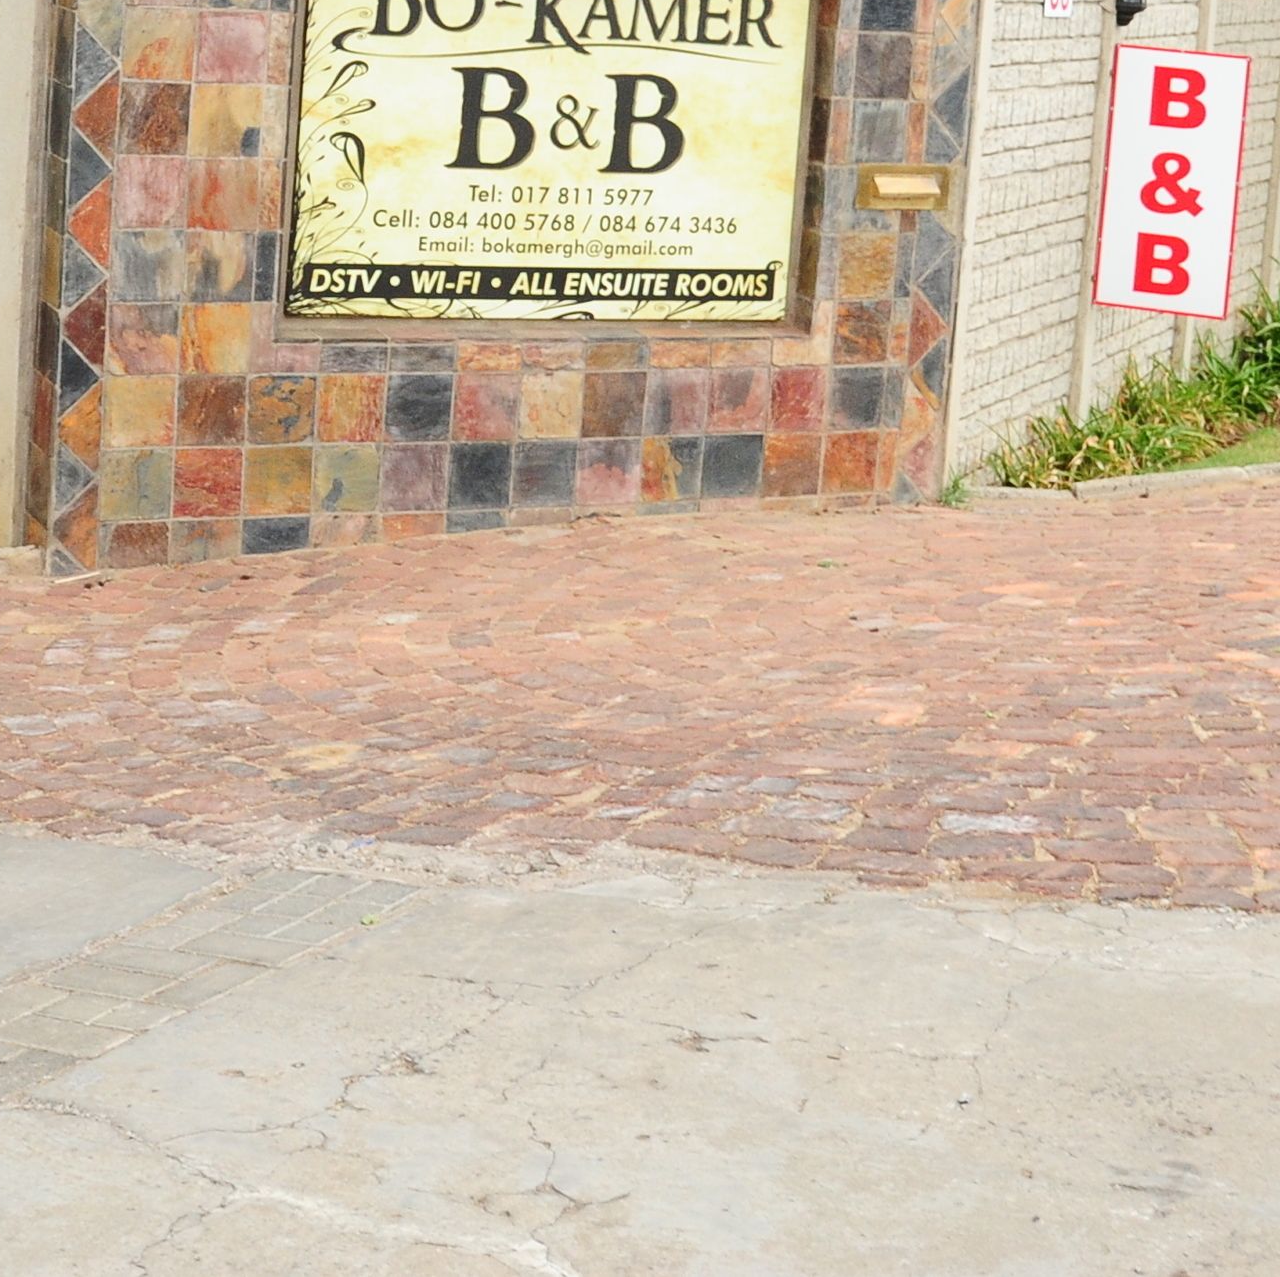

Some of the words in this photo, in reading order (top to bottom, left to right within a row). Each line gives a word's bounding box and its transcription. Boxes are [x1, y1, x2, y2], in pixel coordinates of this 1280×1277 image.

[469, 184, 502, 202] Tel:
[511, 185, 550, 204] 017
[558, 187, 593, 204] 811
[604, 188, 654, 206] 5977
[373, 209, 419, 228] Cell:
[429, 211, 468, 229] 084
[477, 212, 516, 230] 400
[524, 213, 575, 232] 5768
[599, 215, 636, 232] 084
[645, 216, 681, 233] 674
[689, 216, 738, 234] 3436
[418, 236, 474, 253] Email:
[482, 237, 693, 259] bokamergh@gmail.com
[309, 268, 382, 293] DSTV
[410, 270, 481, 295] WI-FI
[509, 271, 557, 296] ALL
[563, 272, 670, 297] ENSUITE
[674, 273, 769, 297] ROOMS
